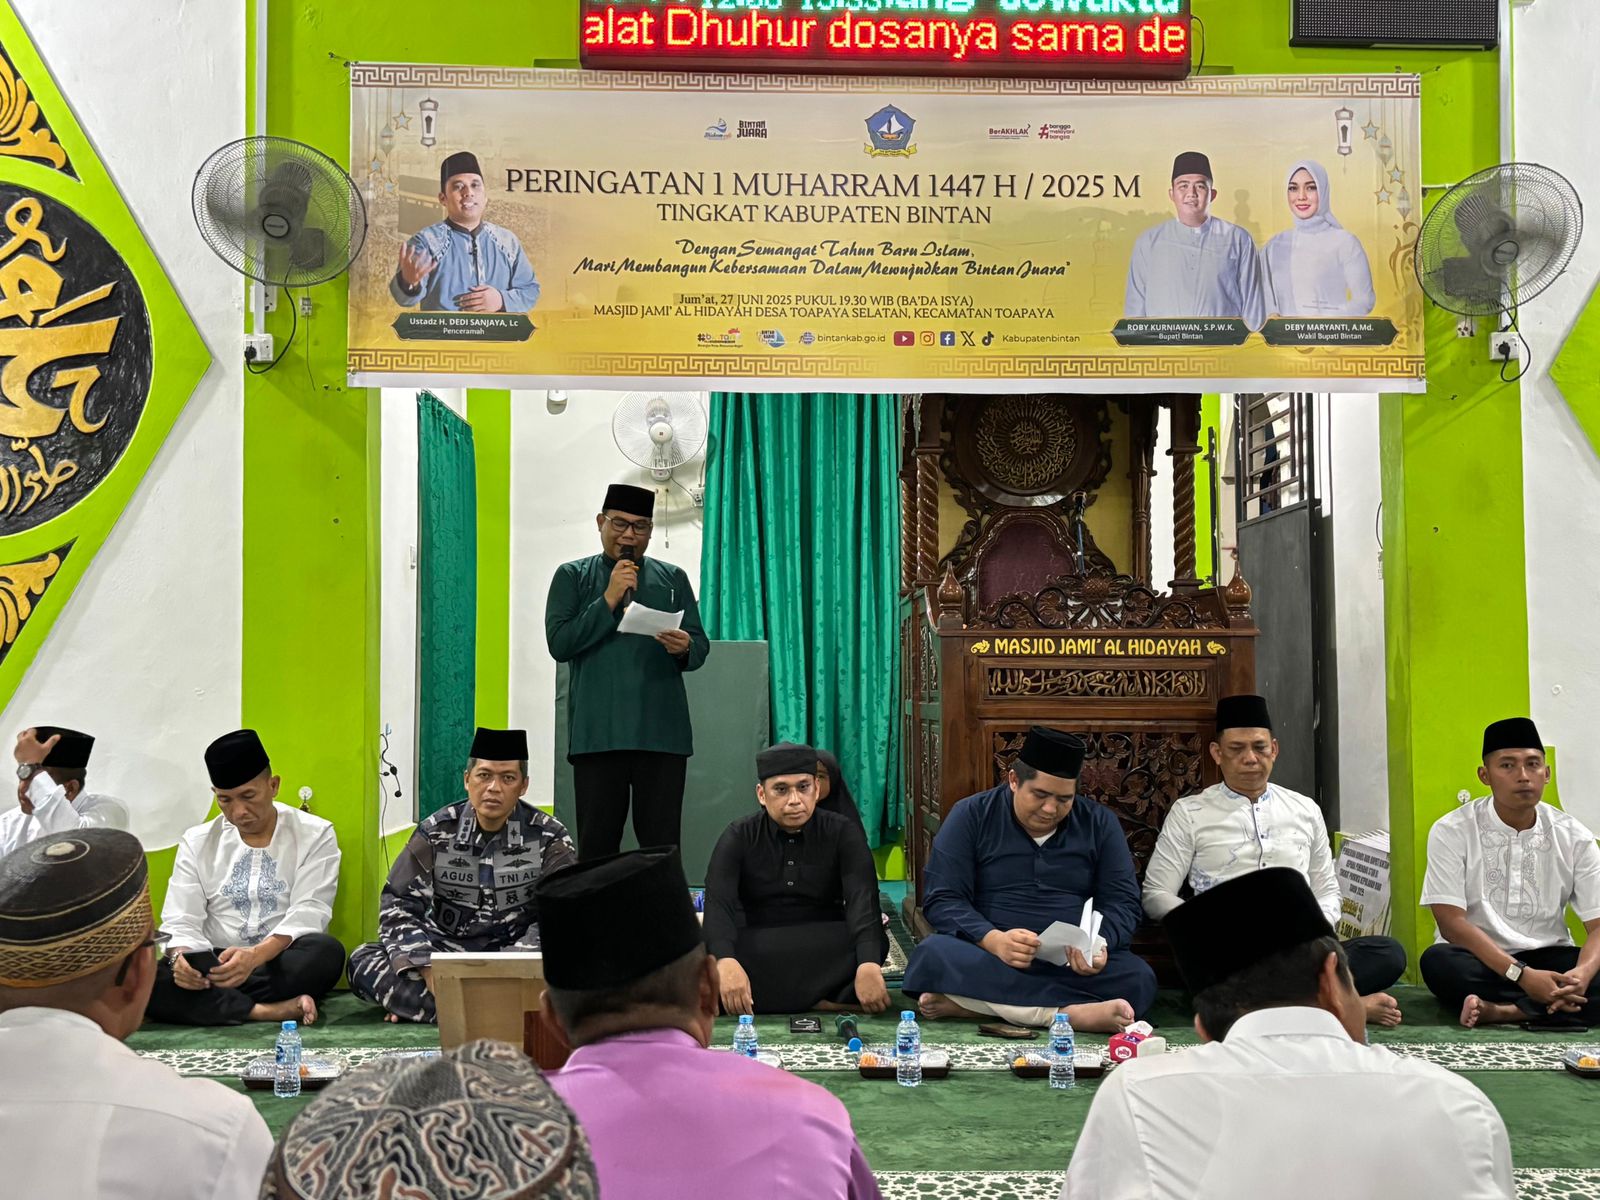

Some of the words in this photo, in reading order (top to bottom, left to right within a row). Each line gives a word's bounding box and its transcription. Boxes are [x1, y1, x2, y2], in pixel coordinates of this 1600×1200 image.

[584, 7, 654, 45] alat
[667, 8, 817, 47] Dhuhur
[829, 11, 997, 58] dosanya
[1011, 22, 1123, 52] sama
[1138, 16, 1185, 53] de
[739, 120, 766, 128] BINTAN
[737, 128, 768, 138] JUARA
[505, 168, 705, 195] PERINGATAN
[732, 172, 921, 198] MUHARRAM
[929, 174, 986, 198] 1447
[993, 174, 1017, 198] H
[1023, 173, 1034, 200] /
[1042, 174, 1105, 198] 2025
[1113, 174, 1141, 198] M
[656, 203, 758, 222] TINGKAT
[764, 204, 901, 223] KABUPATEN
[906, 205, 991, 224] BINTAN
[675, 239, 737, 260] Dengan
[736, 240, 817, 260] Semangat
[820, 240, 875, 258] Tahun
[878, 241, 918, 257] Baru
[573, 257, 616, 275] Mari
[614, 257, 707, 278] Membangun
[709, 258, 807, 275] Kebersamaan
[809, 259, 863, 276] Dalam
[861, 260, 958, 280] Mewujudkan
[961, 260, 1015, 276] Bintan
[720, 294, 734, 305] 27
[735, 295, 763, 307] JUNI
[766, 295, 792, 306] 2025
[795, 295, 837, 306] PUKUL
[839, 295, 867, 306] 19.30
[869, 296, 894, 306] WIB
[941, 295, 974, 308] ISYA)
[594, 305, 639, 318] MASJID
[675, 306, 691, 317] AL
[694, 306, 752, 318] HIDAYAH
[755, 307, 788, 318] DESA
[790, 307, 849, 318] TOAPAYA
[851, 308, 911, 320] SELATAN,
[914, 308, 992, 319] KECAMATAN
[995, 308, 1055, 319] TOAPAYA
[439, 318, 447, 326] H.
[449, 318, 469, 326] DEDI
[470, 319, 508, 327] SANJAYA,
[1284, 323, 1305, 331] DEBY
[443, 327, 485, 335] Penceramah
[1158, 333, 1181, 341] Bupati
[1317, 333, 1339, 341] Bupati
[817, 333, 886, 344] bintankab.go.id
[1002, 334, 1080, 343] Kabupatenbintan
[994, 638, 1055, 655] MASJID
[1104, 639, 1125, 655] AL
[1128, 639, 1202, 655] HIDAYAH
[440, 870, 474, 882] AGUS
[499, 874, 518, 884] TNI
[522, 871, 537, 880] AL
